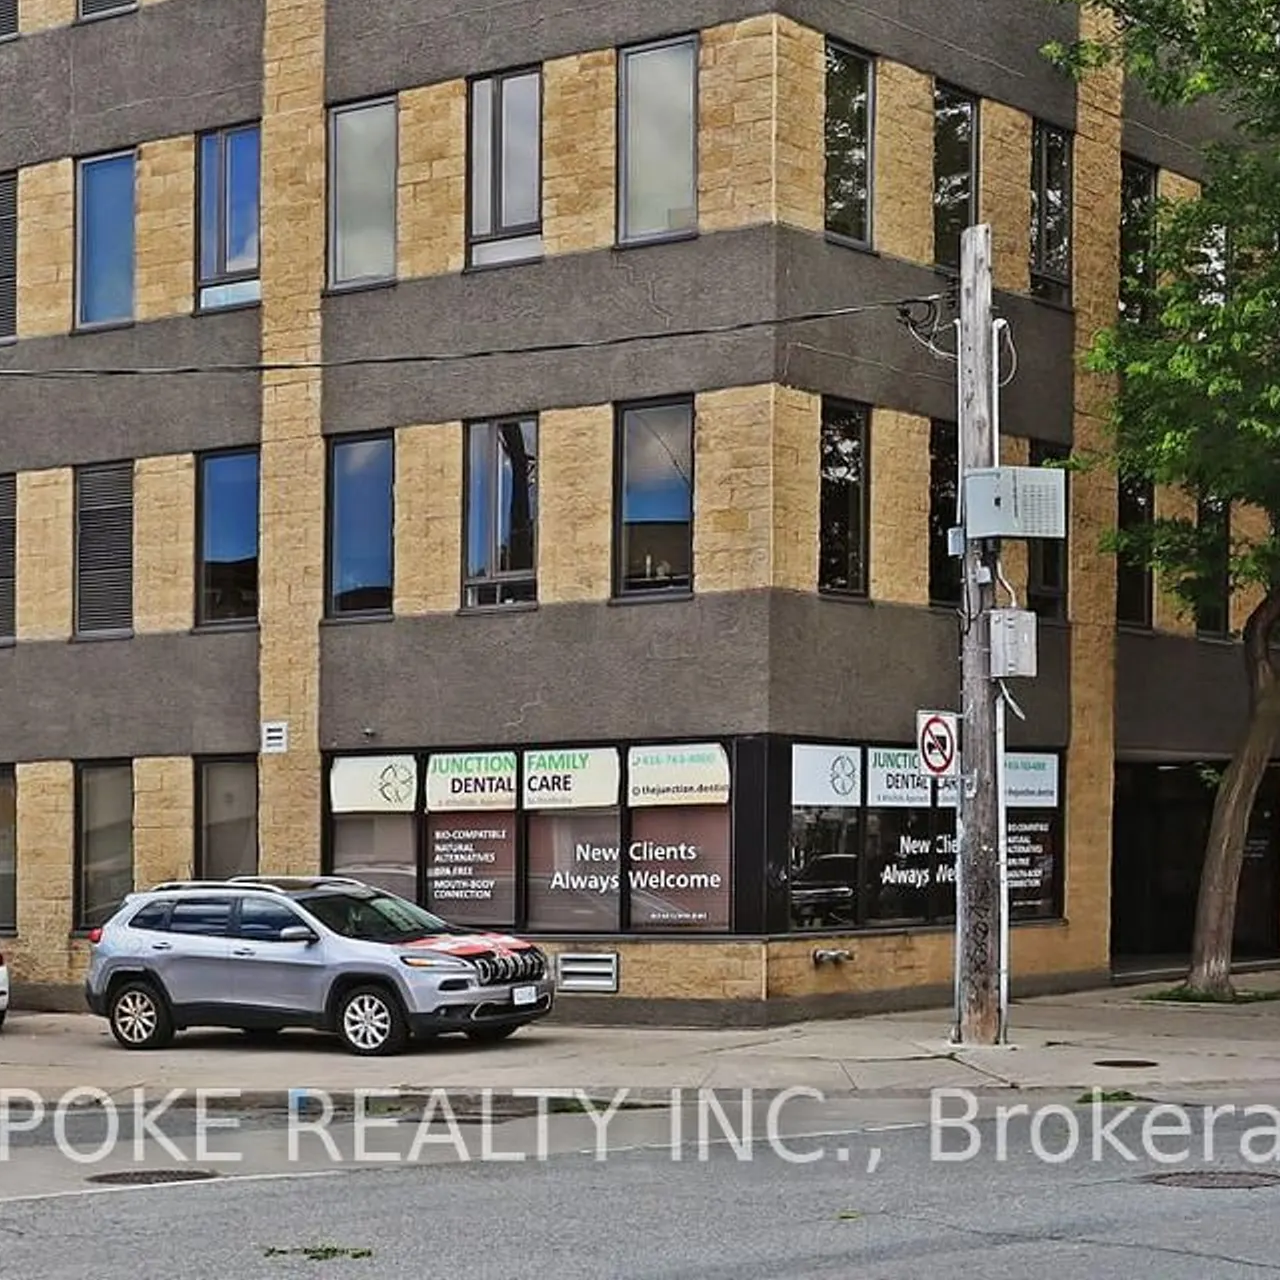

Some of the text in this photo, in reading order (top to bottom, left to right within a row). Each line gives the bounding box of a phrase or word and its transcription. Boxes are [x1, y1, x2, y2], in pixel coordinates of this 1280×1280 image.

[432, 752, 590, 774] JUNCTION FAMILY
[451, 774, 572, 794] DENTAL CARE
[886, 773, 929, 790] DENTAL
[434, 829, 506, 840] BIO-COMPATIBLE
[434, 843, 474, 853] NATURAL
[575, 841, 698, 862] New Clients
[899, 835, 932, 854] New
[434, 852, 496, 863] ALTERNATIVES
[433, 880, 496, 889] MOUTH-BODY
[550, 870, 722, 894] Always Welcome
[881, 864, 930, 889] Always
[433, 889, 492, 899] CONNECTION
